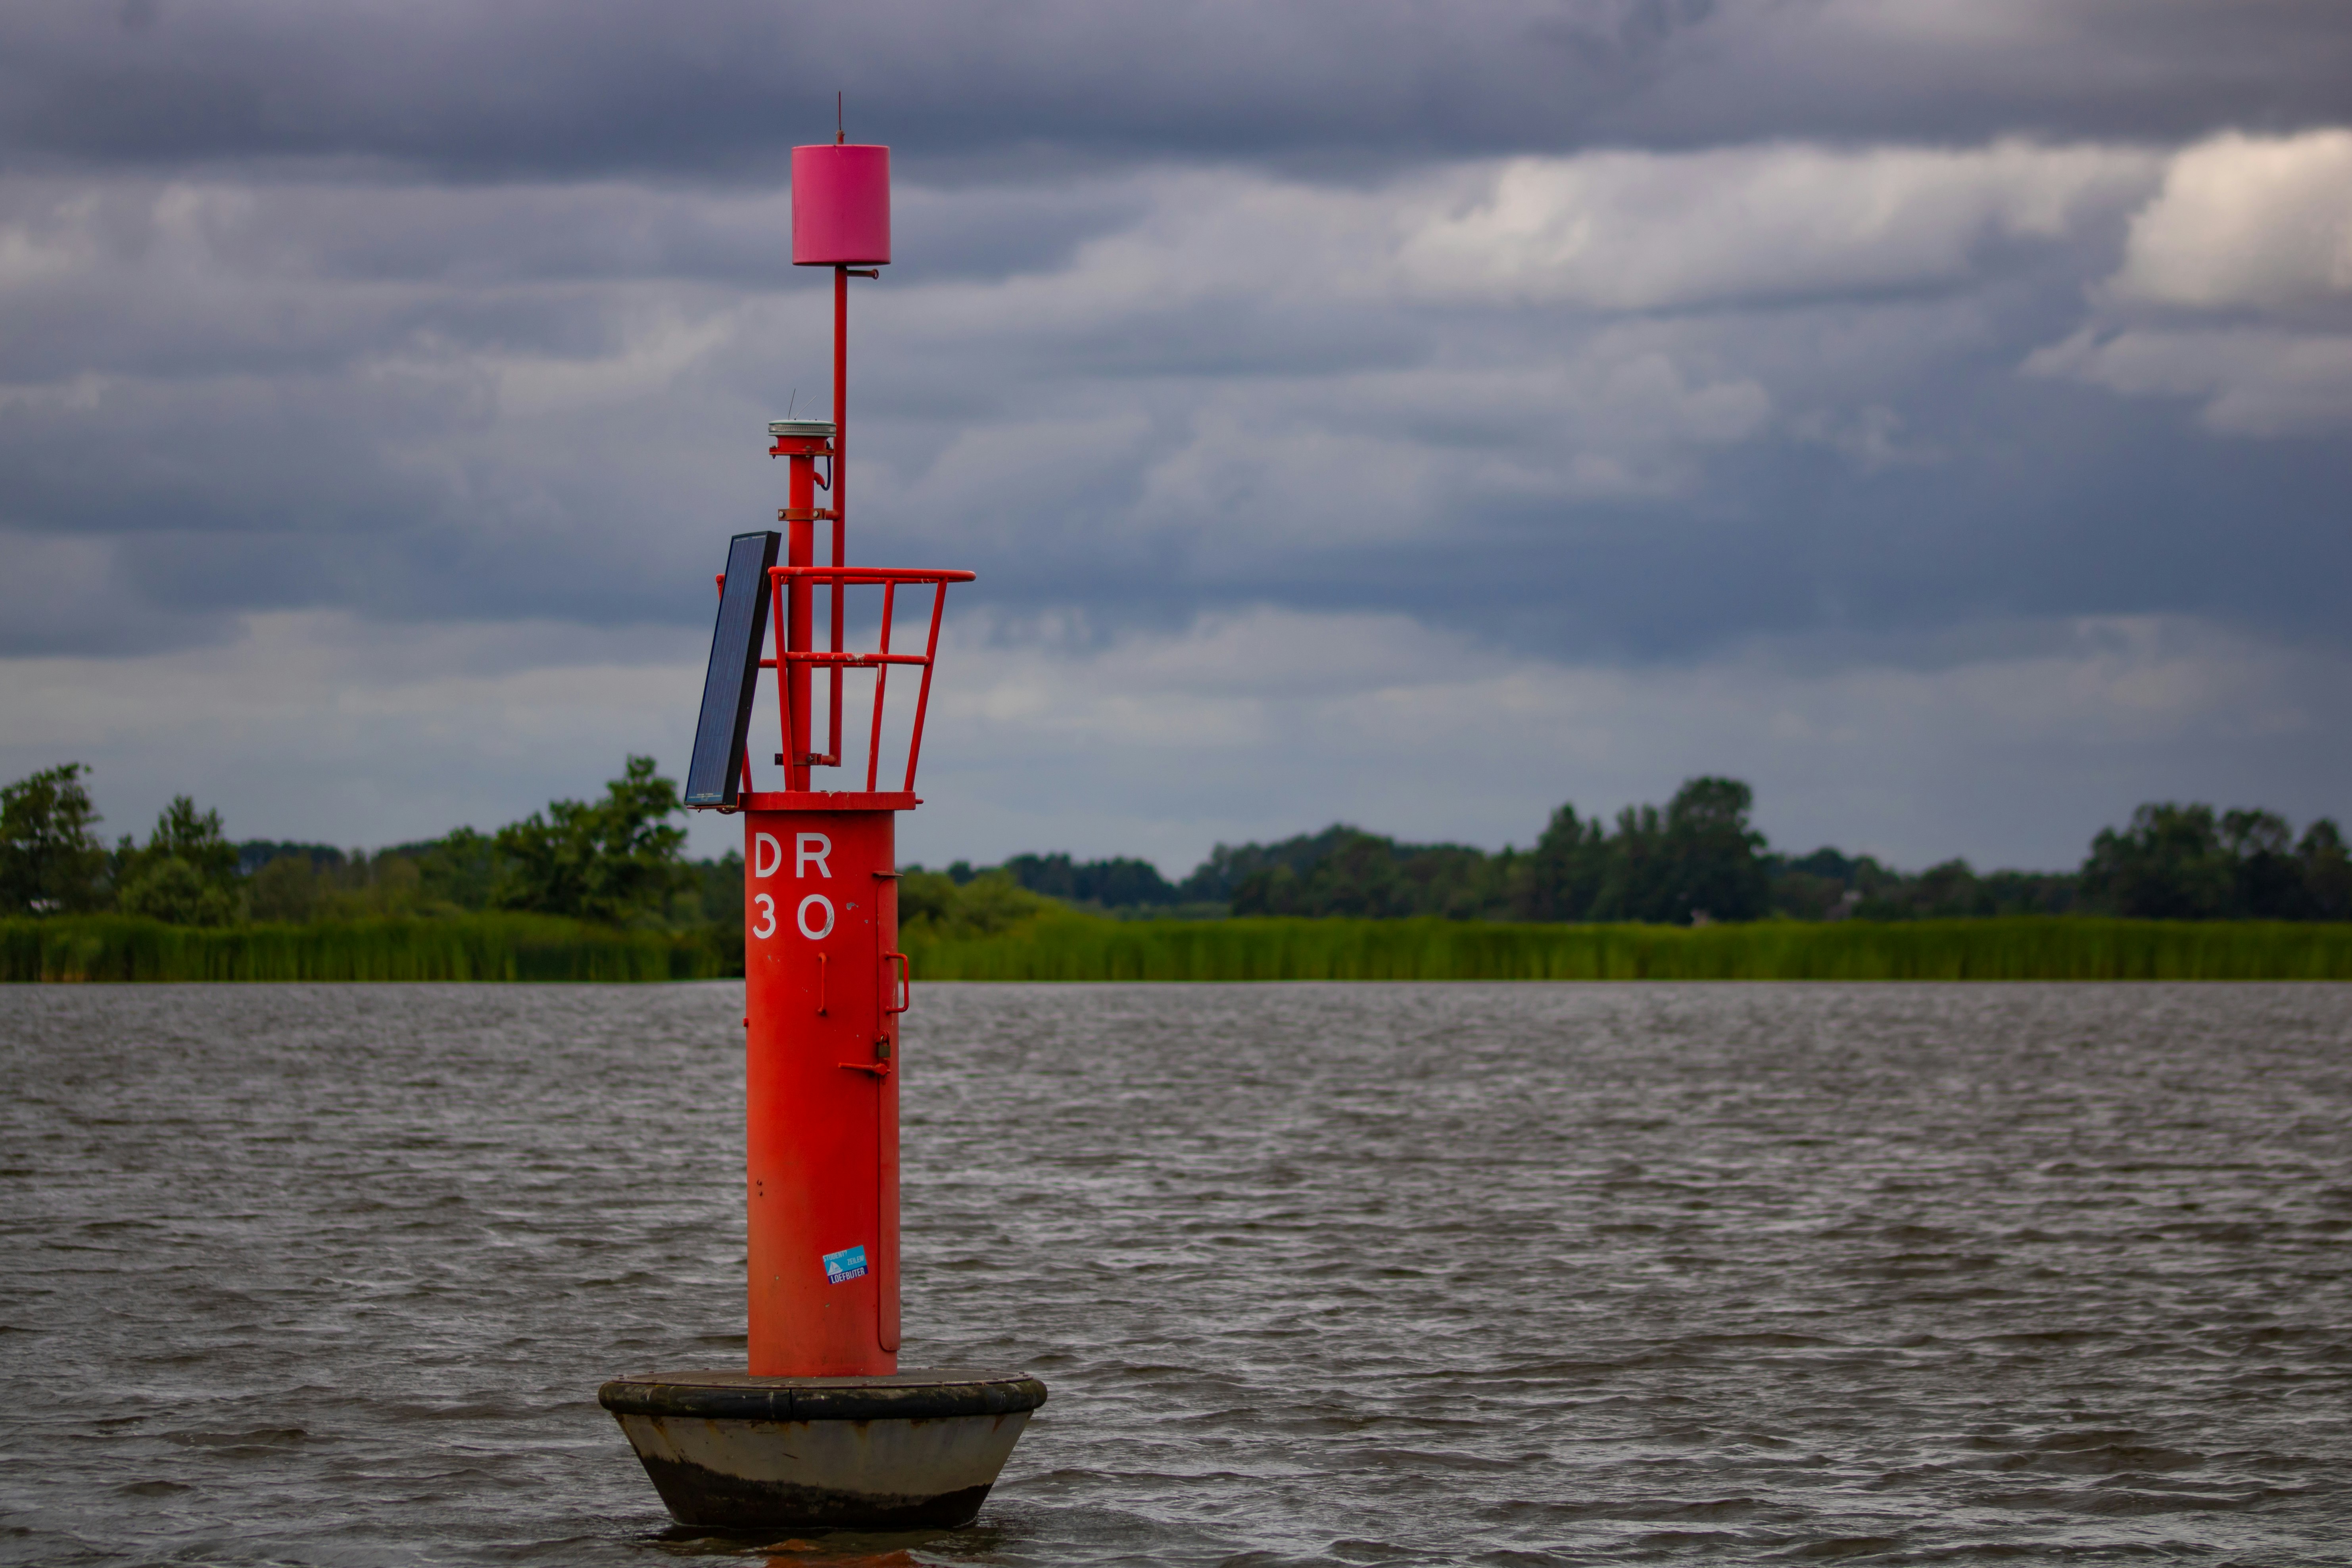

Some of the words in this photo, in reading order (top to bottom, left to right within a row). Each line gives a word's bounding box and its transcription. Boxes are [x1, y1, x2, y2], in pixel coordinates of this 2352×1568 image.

[756, 833, 832, 877] DR
[753, 893, 834, 940] 30
[823, 1250, 847, 1262] STUDENT?
[831, 1267, 865, 1284] LOEFBIJTER
